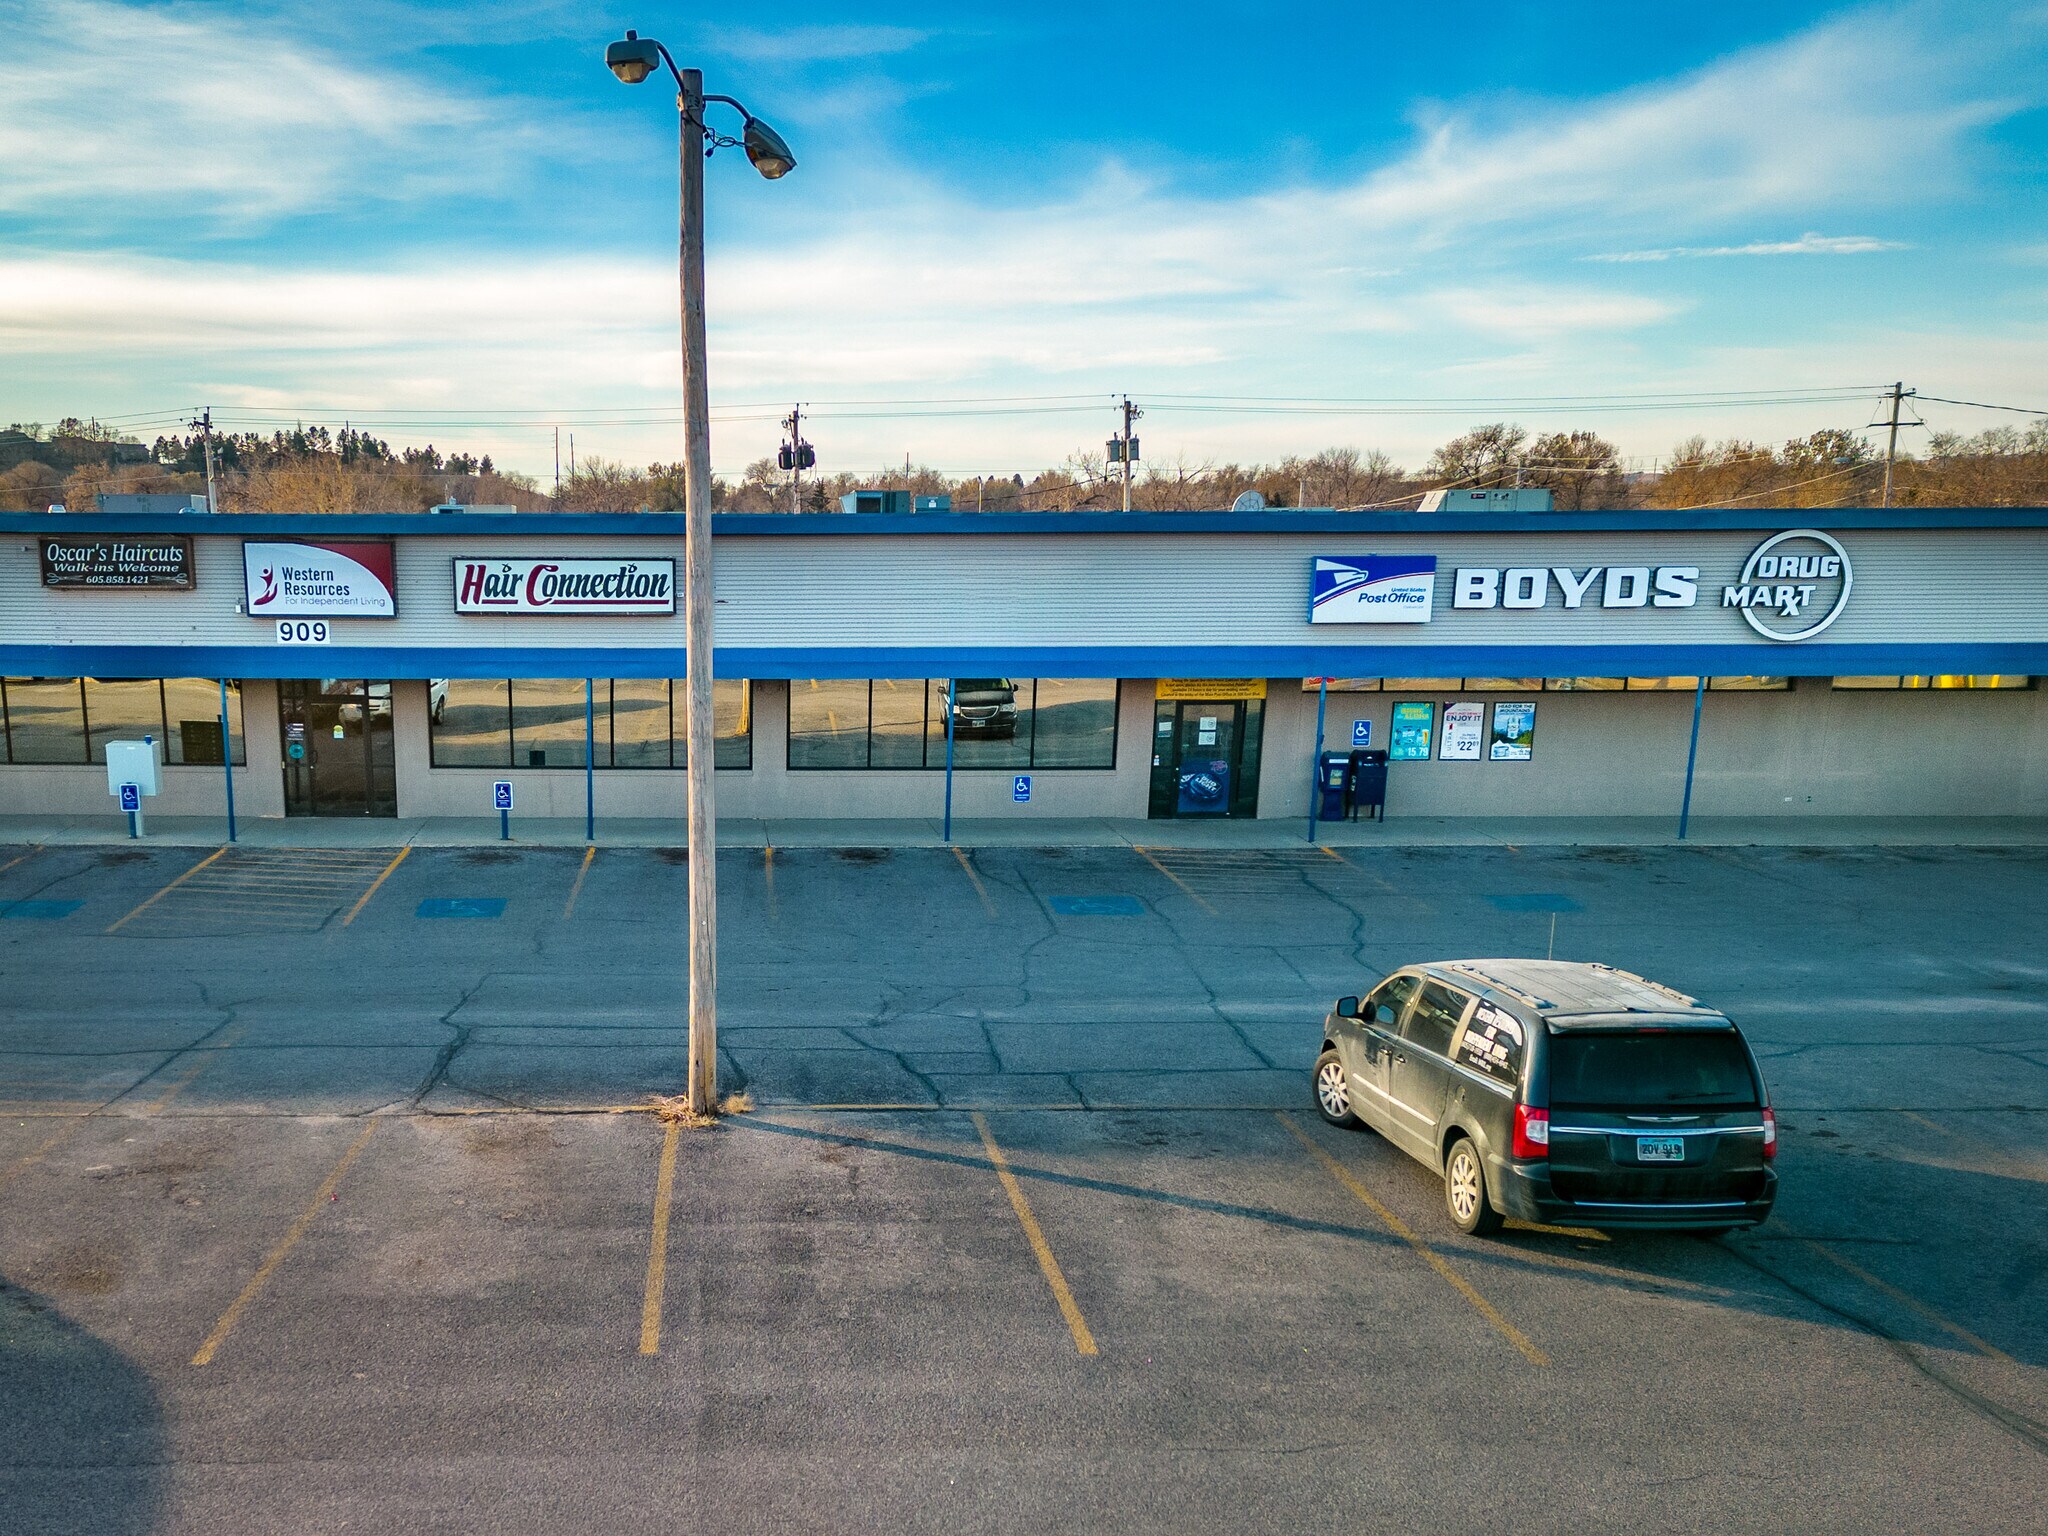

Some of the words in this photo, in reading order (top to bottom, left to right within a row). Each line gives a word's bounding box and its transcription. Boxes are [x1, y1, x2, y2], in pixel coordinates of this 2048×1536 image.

[47, 543, 108, 562] Oscar's
[111, 543, 183, 562] Haircuts
[54, 562, 114, 572] Walk-ins
[118, 562, 179, 572] Welcome
[281, 566, 334, 581] Western
[1757, 555, 1840, 578] DRUG
[86, 575, 149, 584] 605.858.1421
[460, 563, 524, 605] Hair
[526, 563, 670, 606] Connection
[284, 581, 350, 596] Resources
[1453, 567, 1700, 609] BOYDS
[285, 596, 299, 605] For
[300, 597, 358, 607] Independent
[360, 597, 386, 607] Living
[1358, 592, 1387, 603] Post
[1387, 592, 1425, 603] Office
[279, 622, 327, 642] 909
